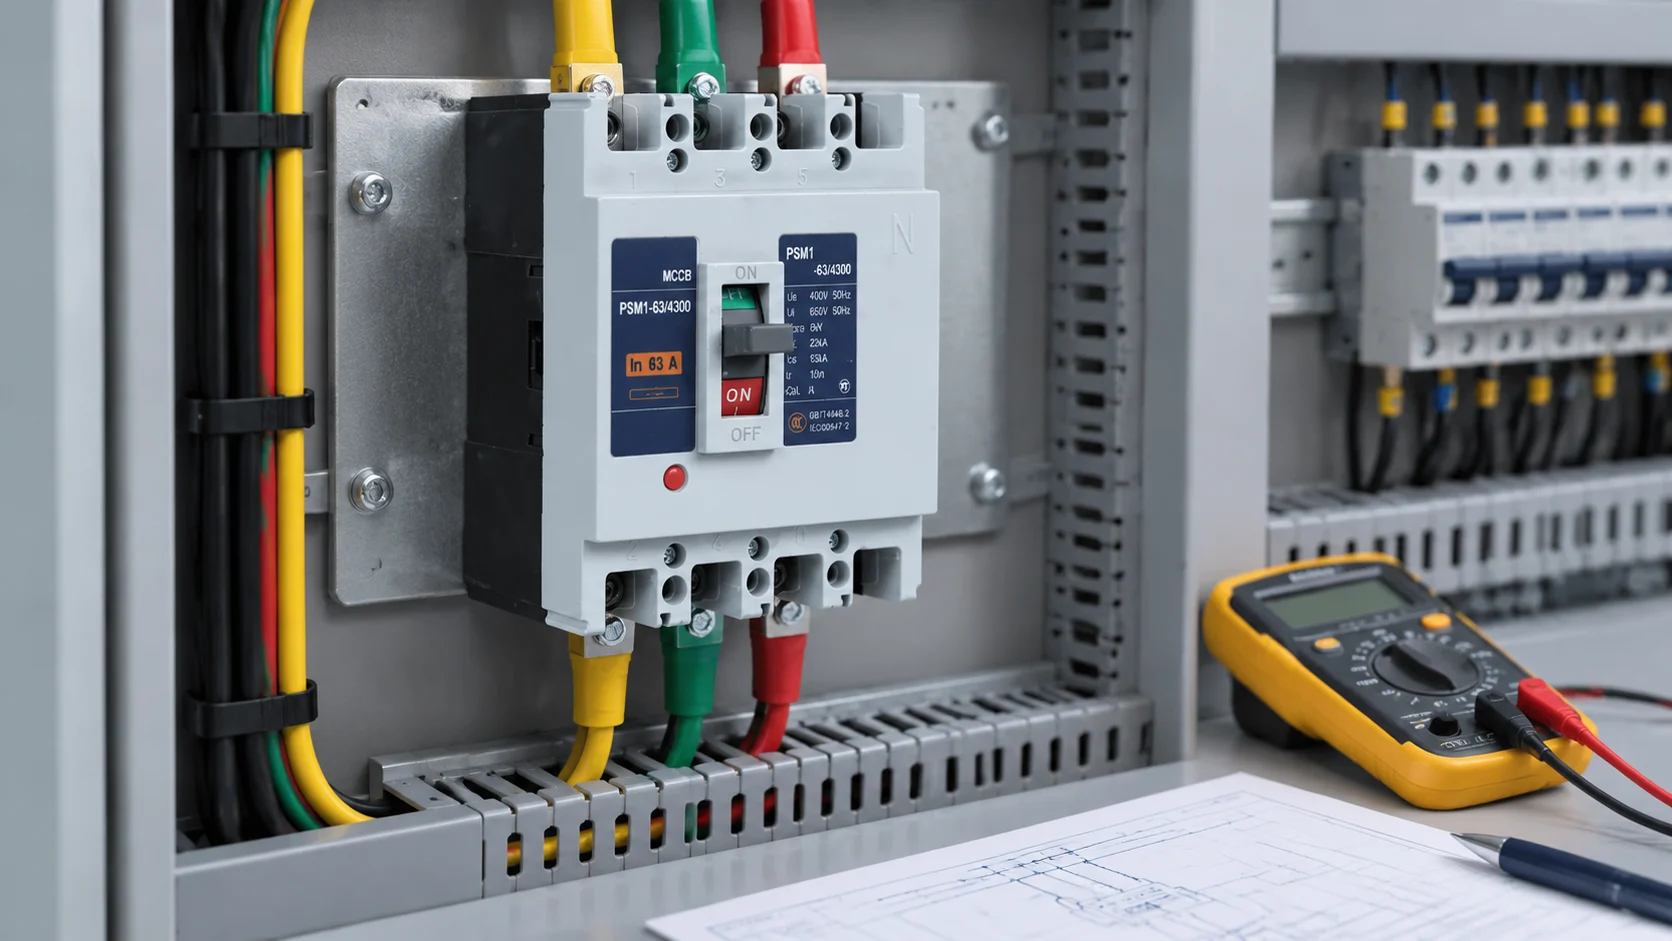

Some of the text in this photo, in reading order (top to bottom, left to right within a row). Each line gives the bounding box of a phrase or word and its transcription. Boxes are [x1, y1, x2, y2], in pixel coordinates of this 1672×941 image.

[713, 168, 726, 188] 3
[797, 168, 808, 186] 5
[892, 213, 914, 255] N
[786, 246, 814, 260] PSM1
[662, 269, 692, 282] MCCB
[735, 265, 757, 280] ON
[813, 263, 852, 276] -63/4300
[809, 291, 828, 301] 400V
[619, 300, 691, 315] PSM1-63/4300
[630, 355, 678, 372] In 63 A
[726, 387, 752, 403] ON
[731, 426, 762, 442] OFF
